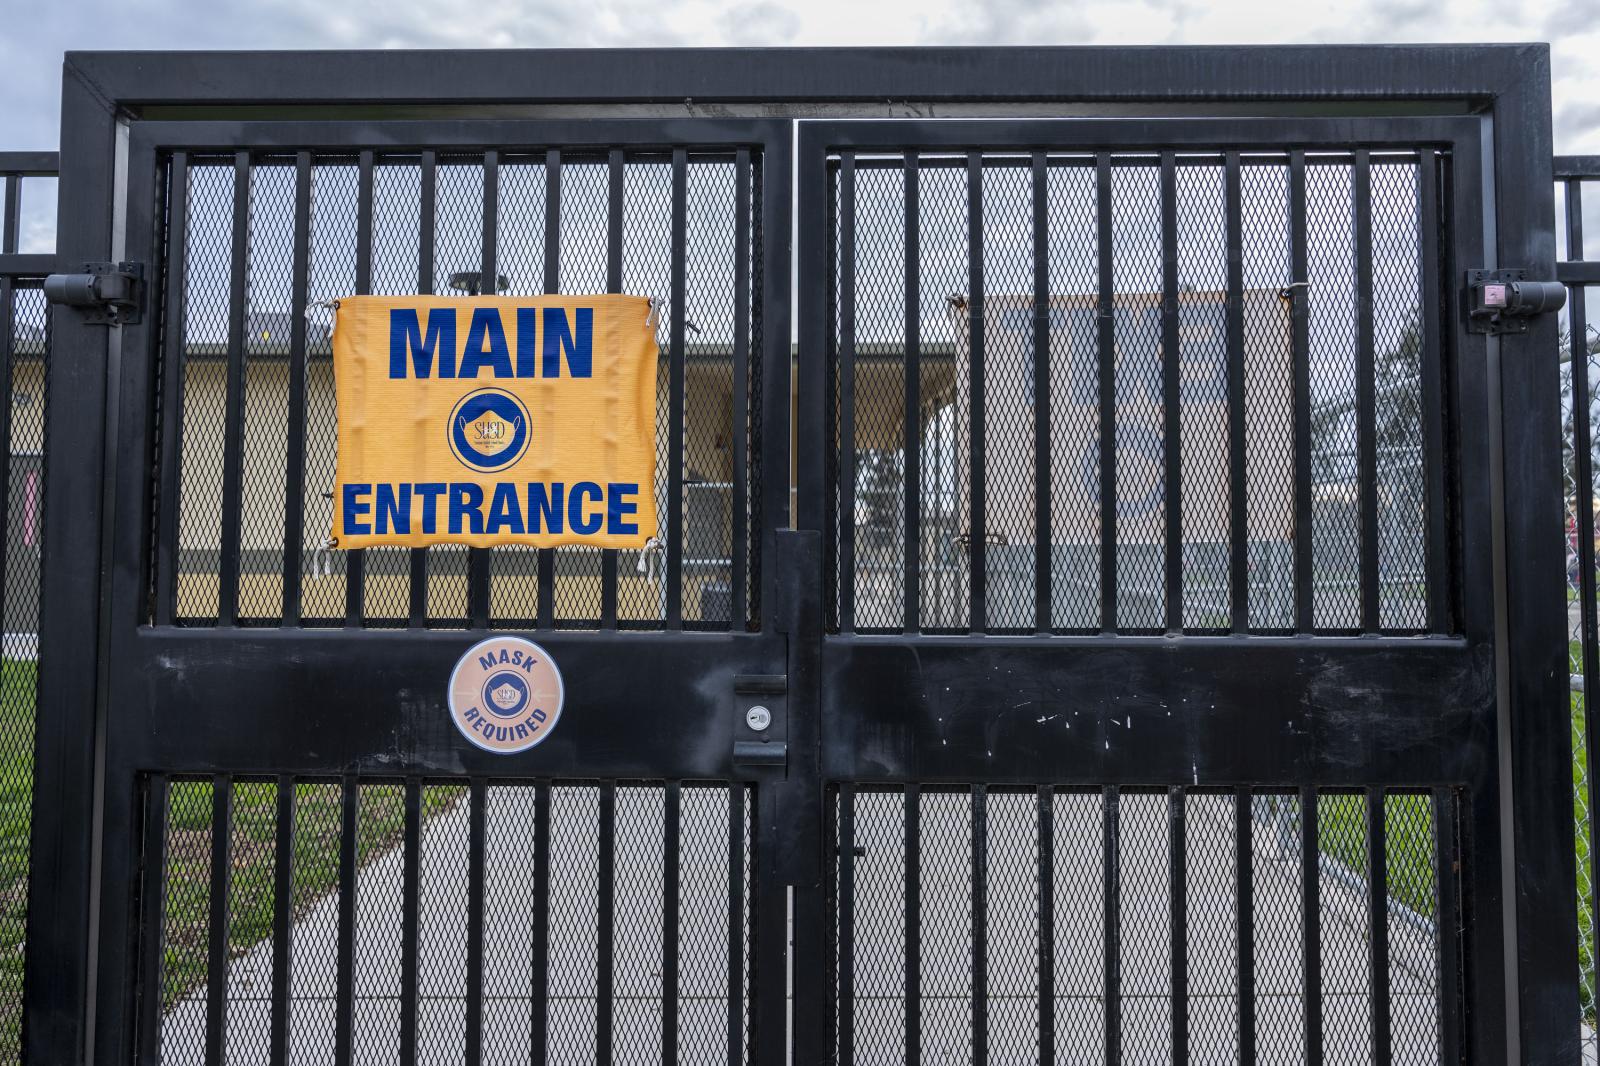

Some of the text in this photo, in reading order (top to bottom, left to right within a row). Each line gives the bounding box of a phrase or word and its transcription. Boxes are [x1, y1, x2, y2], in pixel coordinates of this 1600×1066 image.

[389, 308, 593, 379] MAIN
[474, 421, 505, 440] SUSD
[343, 482, 639, 535] ENTRANCE
[479, 649, 538, 672] MASK
[464, 707, 547, 741] REQUIRED
